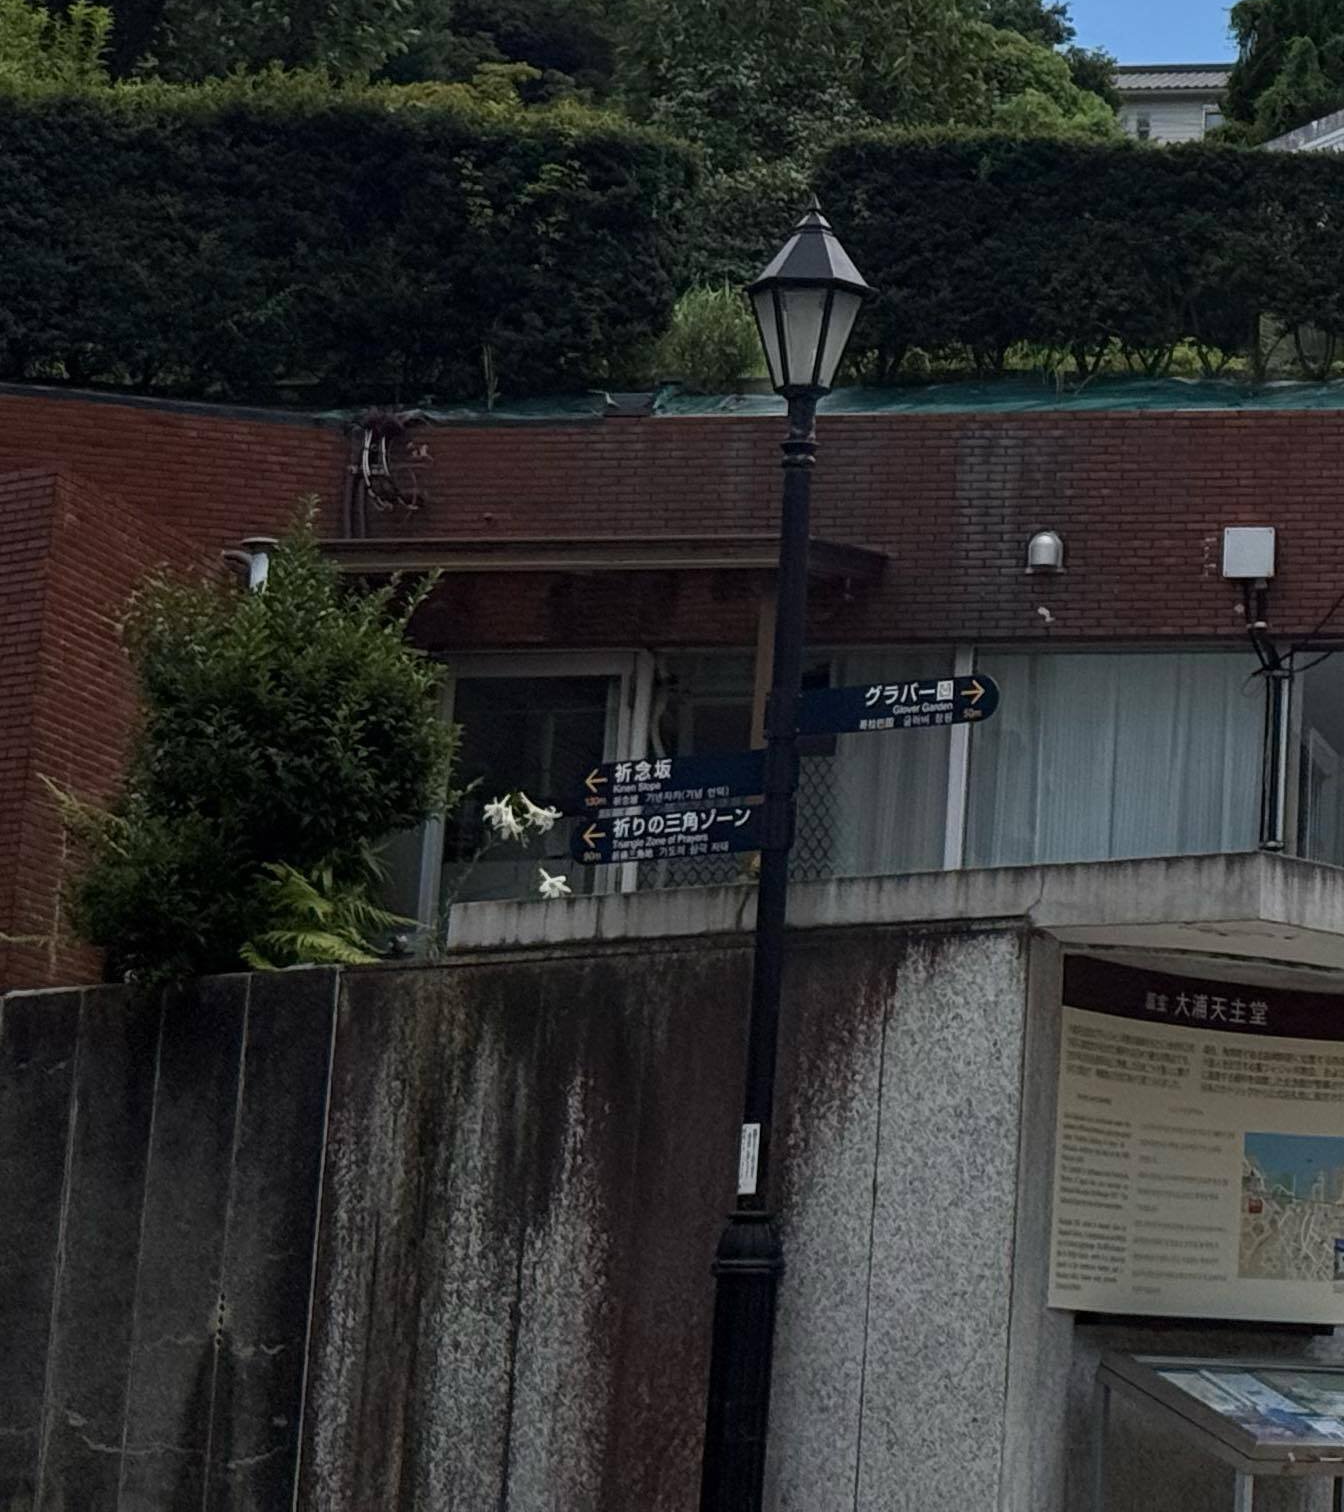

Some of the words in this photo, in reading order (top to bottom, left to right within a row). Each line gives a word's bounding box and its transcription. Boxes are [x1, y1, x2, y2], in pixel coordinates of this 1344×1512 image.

[865, 680, 954, 706] グラバー園
[892, 704, 921, 715] Glover
[922, 702, 953, 712] Garden
[615, 759, 672, 782] 祈念坂
[613, 783, 637, 793] Kinen
[638, 782, 662, 792] Slope
[613, 808, 751, 838] 祈りの三角ゾーン
[645, 838, 666, 846] Zone
[1173, 991, 1268, 1026] 大浦天主堂
